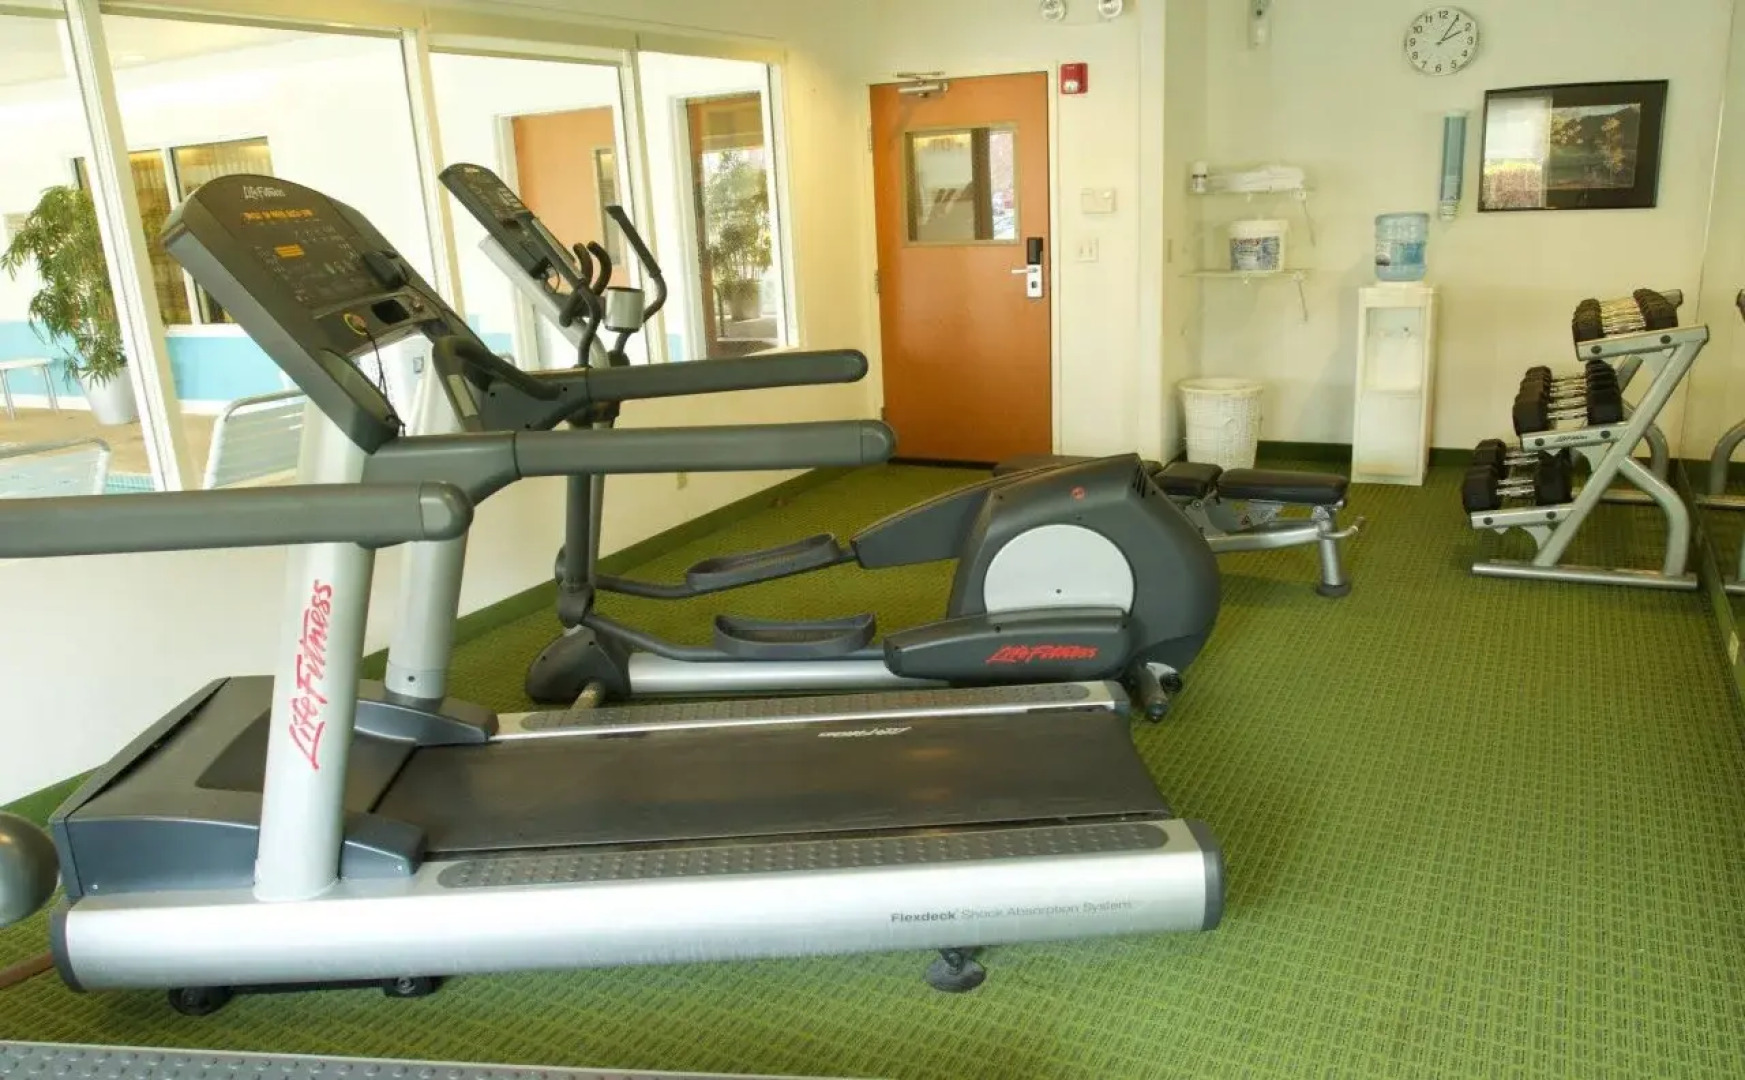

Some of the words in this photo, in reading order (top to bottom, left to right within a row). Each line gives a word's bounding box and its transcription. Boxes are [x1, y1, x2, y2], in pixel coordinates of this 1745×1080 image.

[1425, 15, 1433, 23] 11
[1438, 10, 1449, 19] 12
[1413, 25, 1423, 34] 10
[1465, 22, 1472, 32] 2
[1409, 37, 1416, 47] 9
[1467, 36, 1474, 45] 3
[1411, 51, 1419, 60] 8
[1461, 49, 1468, 57] 4
[1421, 60, 1428, 69] 7
[1435, 63, 1442, 73] 6
[1450, 59, 1457, 69] 5
[961, 908, 1002, 920] Shock
[1007, 904, 1079, 918] Absorption
[1083, 900, 1132, 914] System
